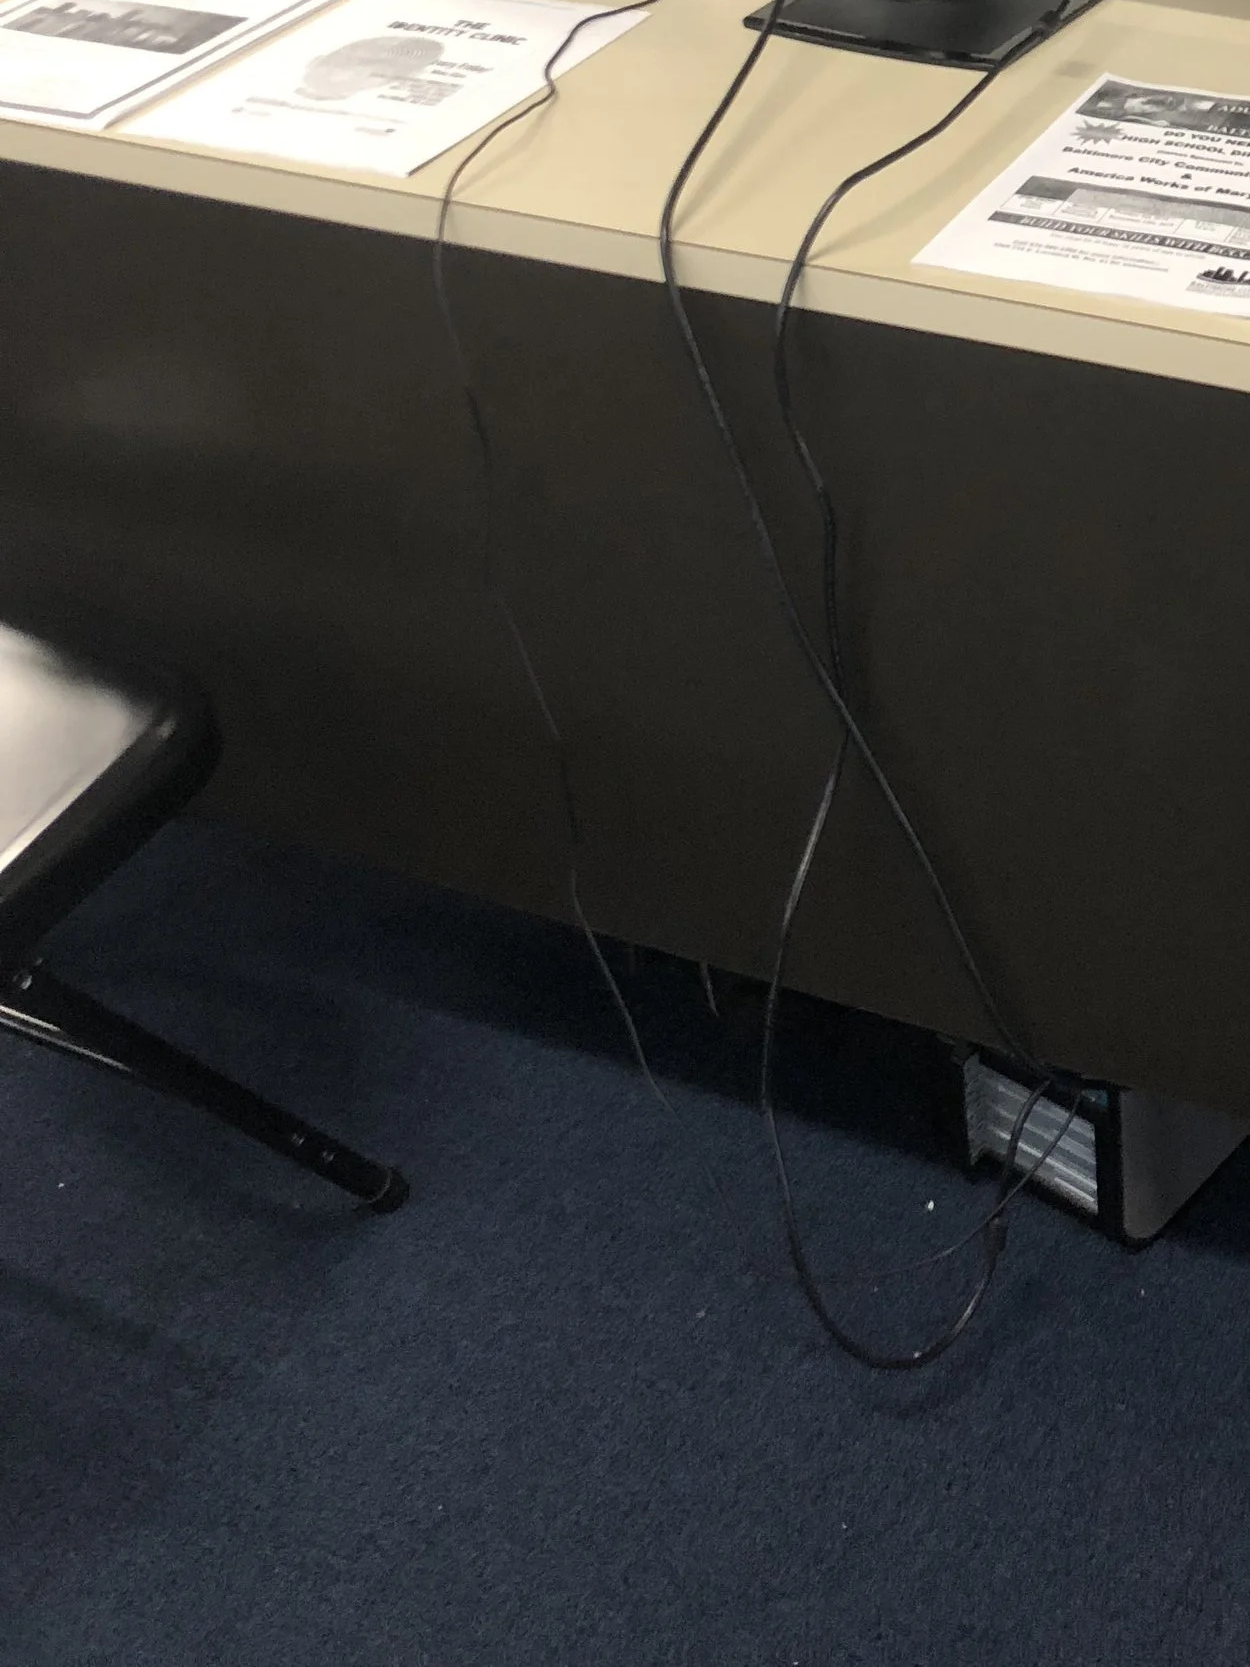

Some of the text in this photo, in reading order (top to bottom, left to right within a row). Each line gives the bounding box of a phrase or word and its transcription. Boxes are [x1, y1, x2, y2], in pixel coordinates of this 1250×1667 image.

[387, 21, 528, 46] IDENTITY CLINIC
[454, 20, 491, 30] THE
[1121, 134, 1160, 146] HIGH
[1164, 139, 1226, 155] SCHOOL
[1164, 130, 1186, 138] DO
[1191, 133, 1221, 143] YOU
[1062, 146, 1134, 162] Baltimore
[1138, 156, 1169, 167] City
[1067, 166, 1135, 183] America
[1140, 176, 1189, 190] Works
[1194, 184, 1212, 192] of
